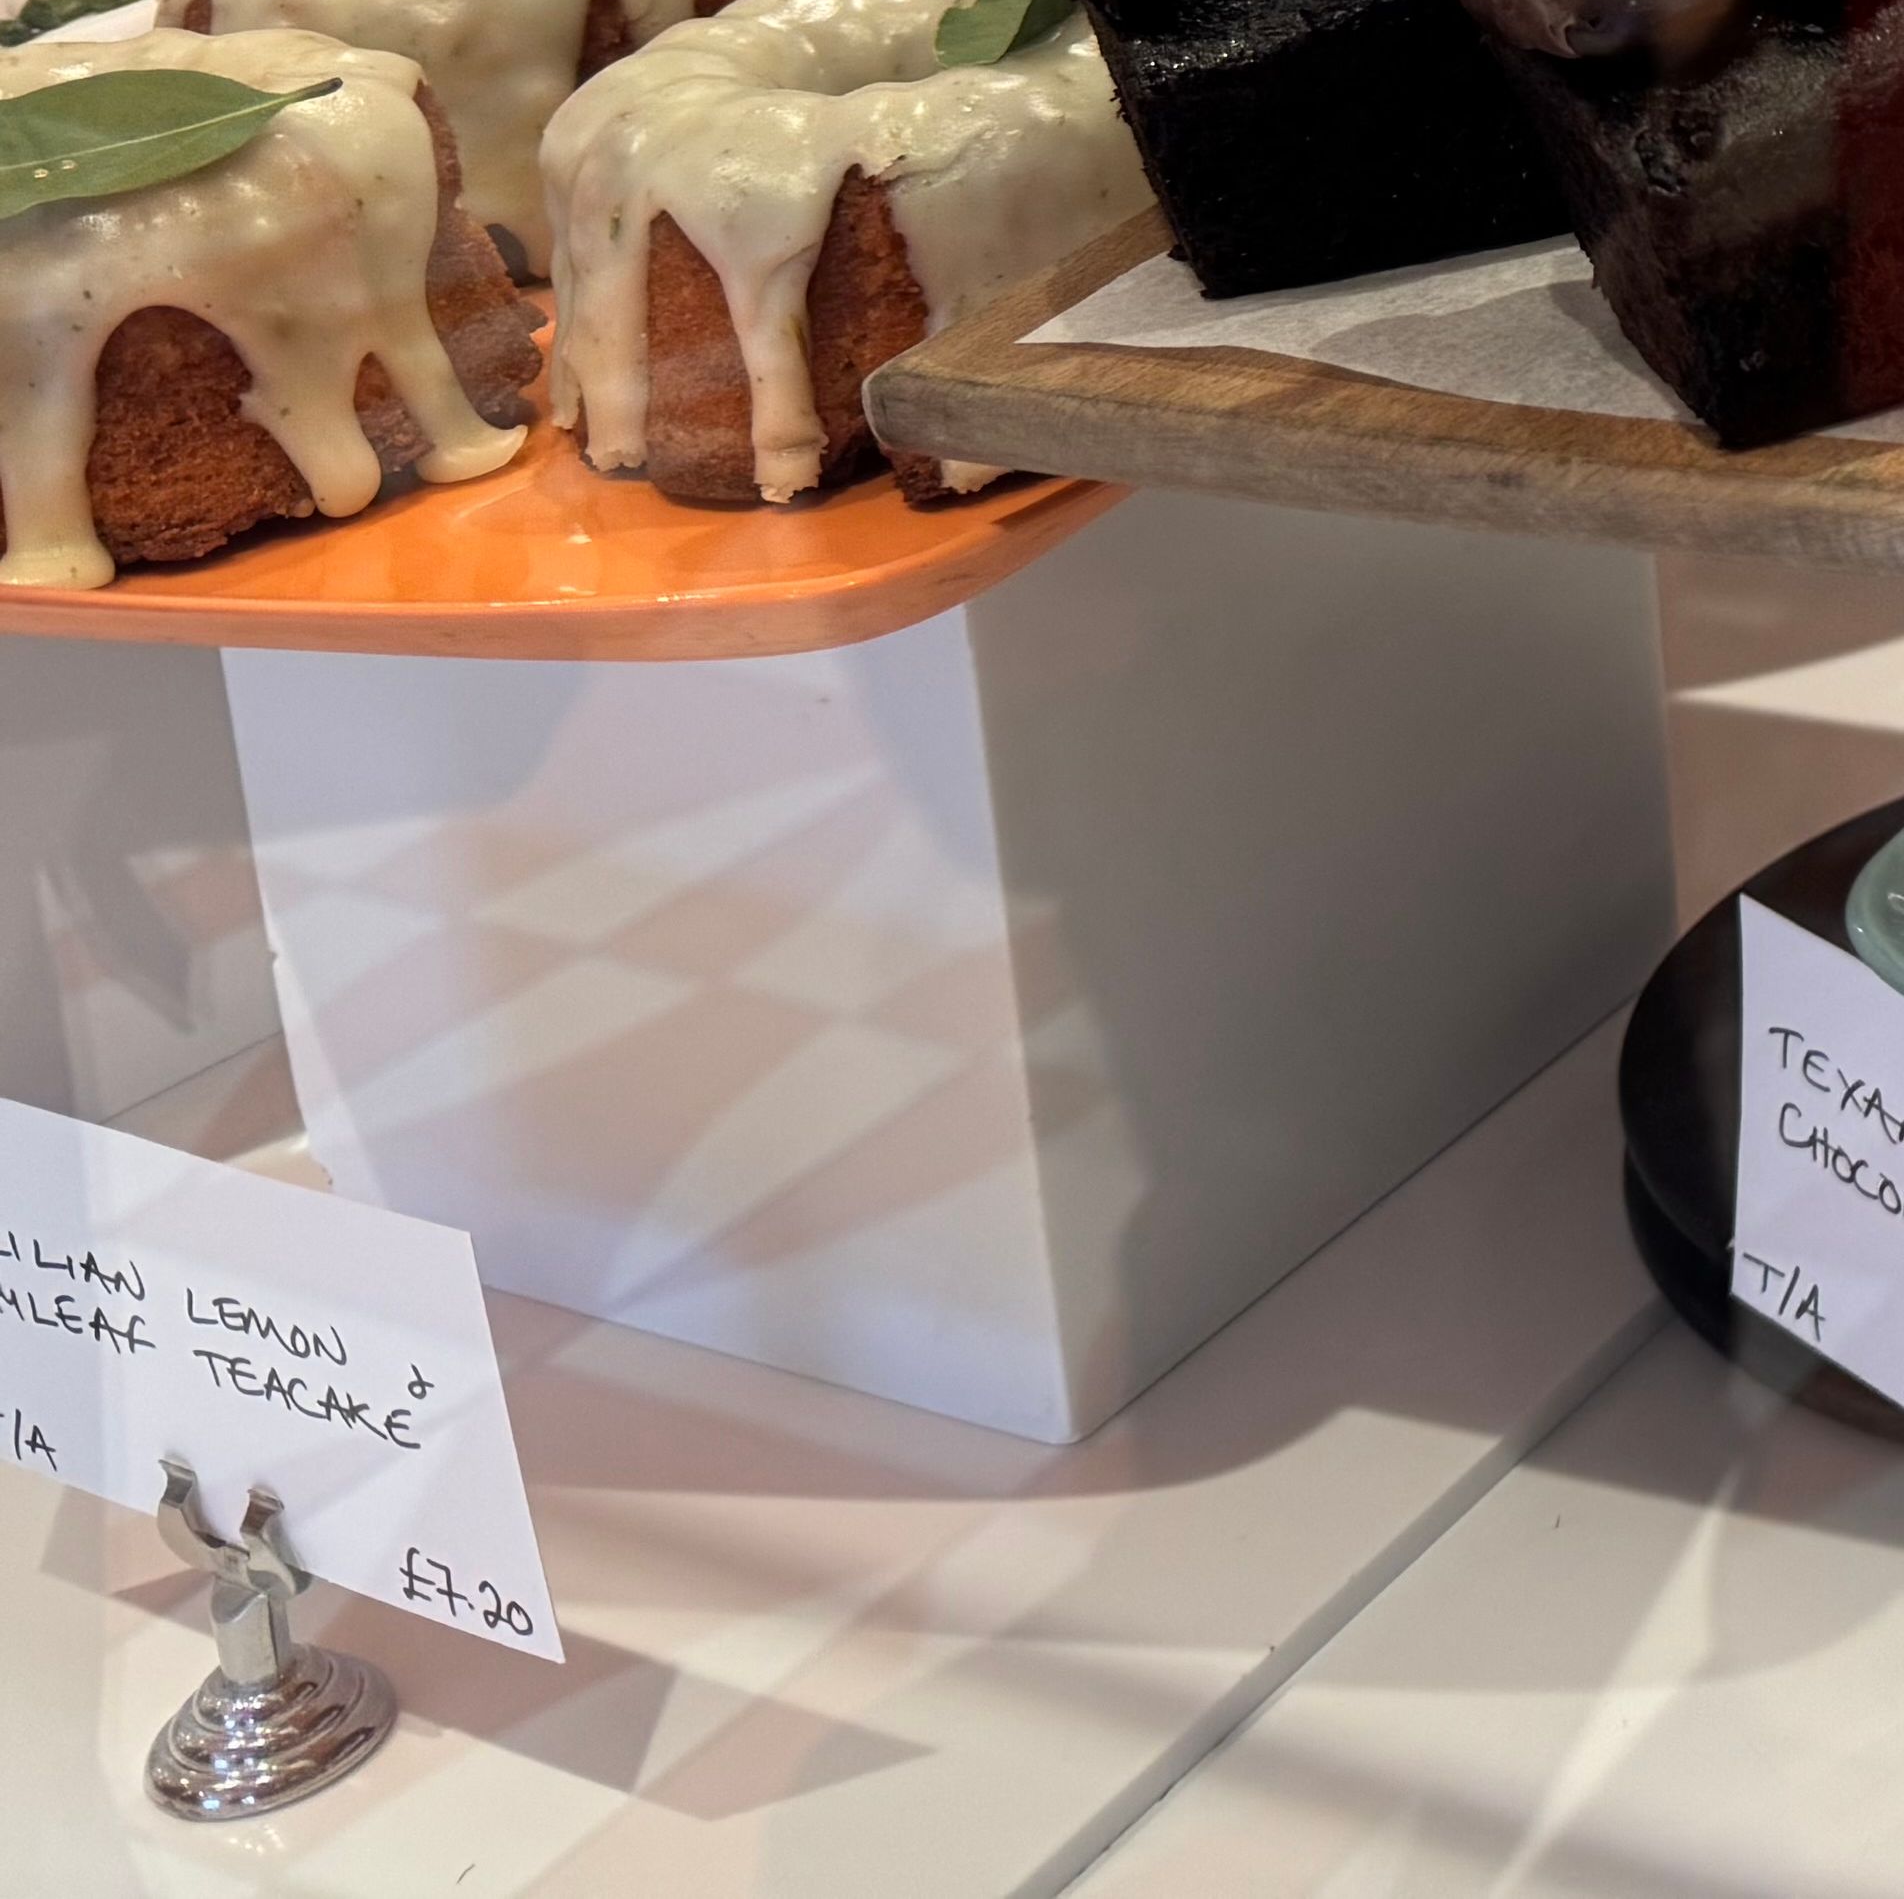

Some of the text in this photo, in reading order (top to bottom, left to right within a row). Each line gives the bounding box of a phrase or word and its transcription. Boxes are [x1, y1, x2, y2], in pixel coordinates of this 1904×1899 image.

[0, 1230, 146, 1301] ILIAN
[186, 1287, 347, 1366] LEMON
[1742, 1250, 1827, 1343] T/A
[0, 1408, 57, 1472] /A
[193, 1348, 422, 1450] TEACAKE
[399, 1546, 534, 1637] £7.20
